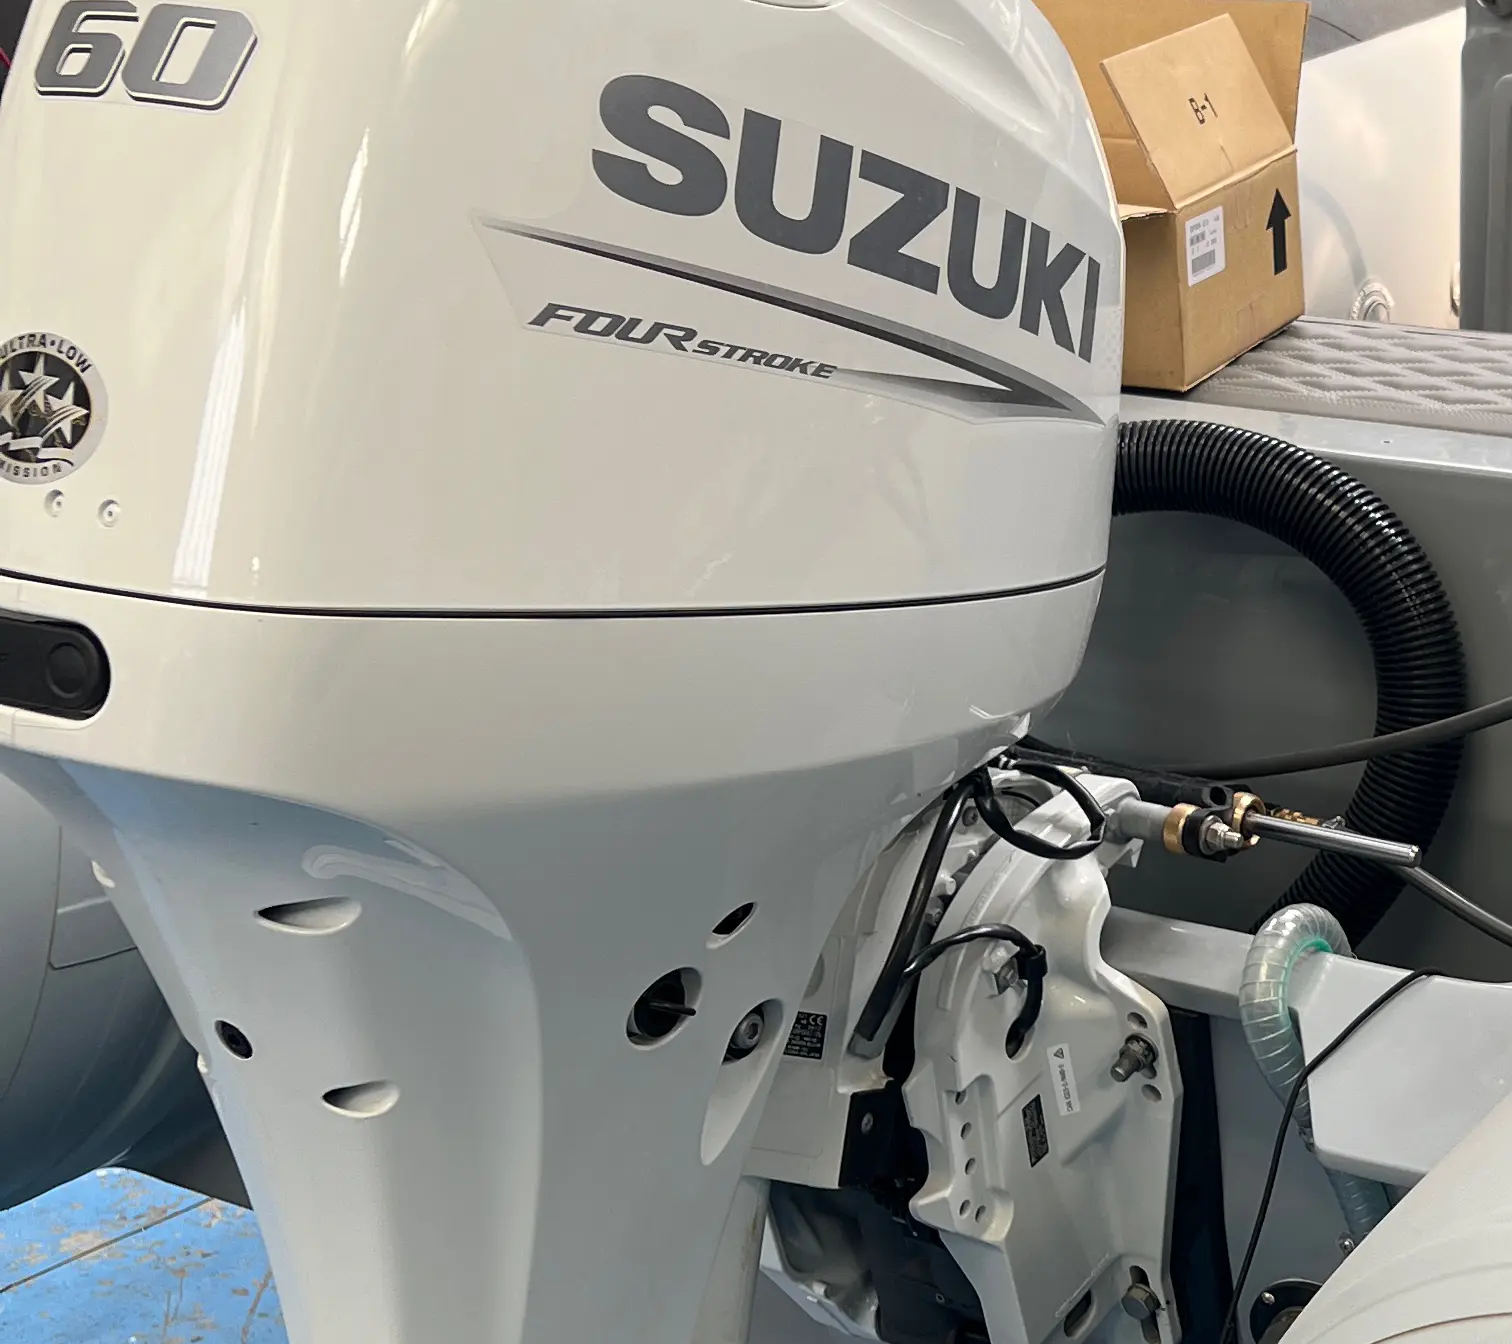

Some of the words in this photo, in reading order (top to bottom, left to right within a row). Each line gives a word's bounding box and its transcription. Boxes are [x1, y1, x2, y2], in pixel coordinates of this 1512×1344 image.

[591, 74, 1101, 364] SUZUKI
[527, 301, 701, 352] FOUR
[691, 339, 839, 380] STROKE
